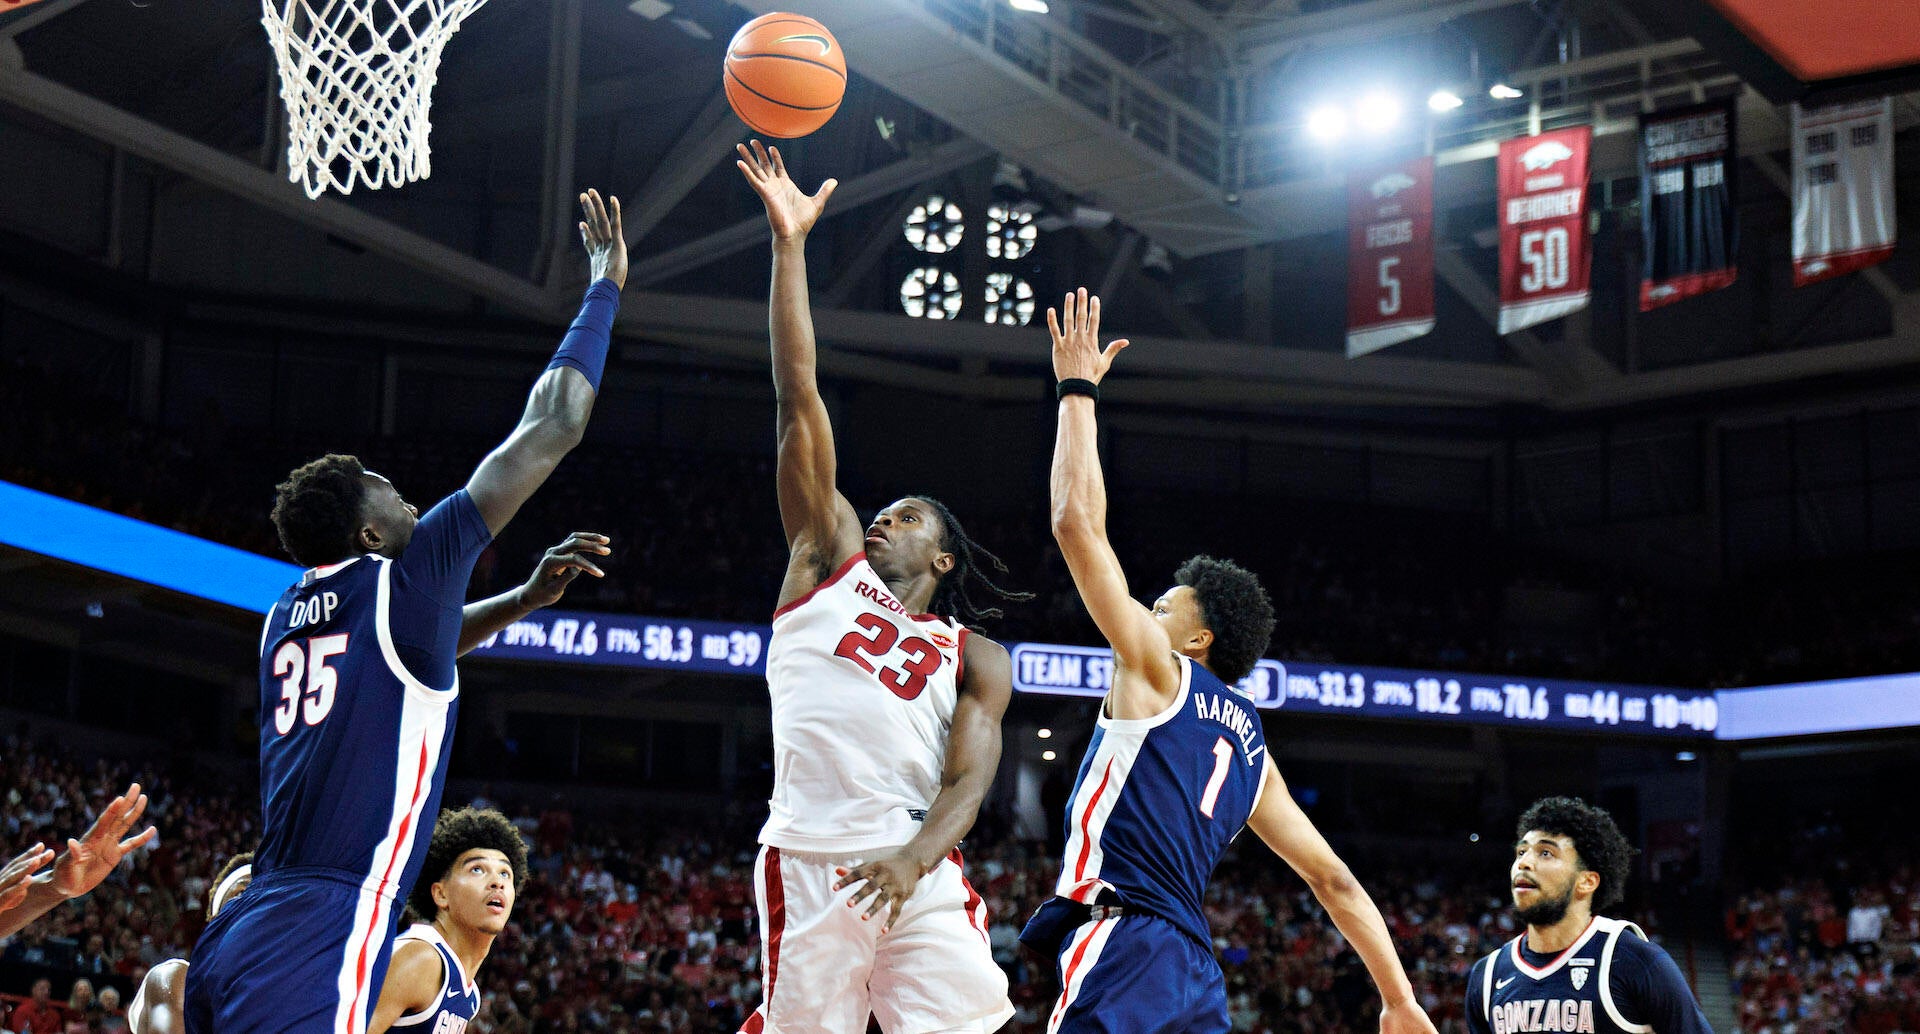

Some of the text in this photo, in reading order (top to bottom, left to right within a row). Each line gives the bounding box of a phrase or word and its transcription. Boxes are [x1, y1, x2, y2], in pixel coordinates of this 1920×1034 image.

[1378, 257, 1401, 316] 5
[1520, 227, 1569, 293] 50
[289, 591, 338, 628] DIOP
[503, 621, 547, 648] 3PT%
[549, 618, 598, 656] 47.6
[606, 627, 642, 654] FT%
[643, 624, 694, 663] 58.3
[729, 630, 762, 666] 39
[833, 612, 943, 701] 23
[1020, 653, 1082, 687] TEAM
[273, 632, 350, 736] 35
[1318, 670, 1365, 708] 33.3
[1414, 677, 1461, 715] 18.2
[1502, 683, 1550, 721] 70.6
[1590, 689, 1620, 725] 44
[1194, 692, 1265, 767] HARWELL
[1200, 735, 1234, 820] 1
[1492, 999, 1596, 1034] GONZAGA
